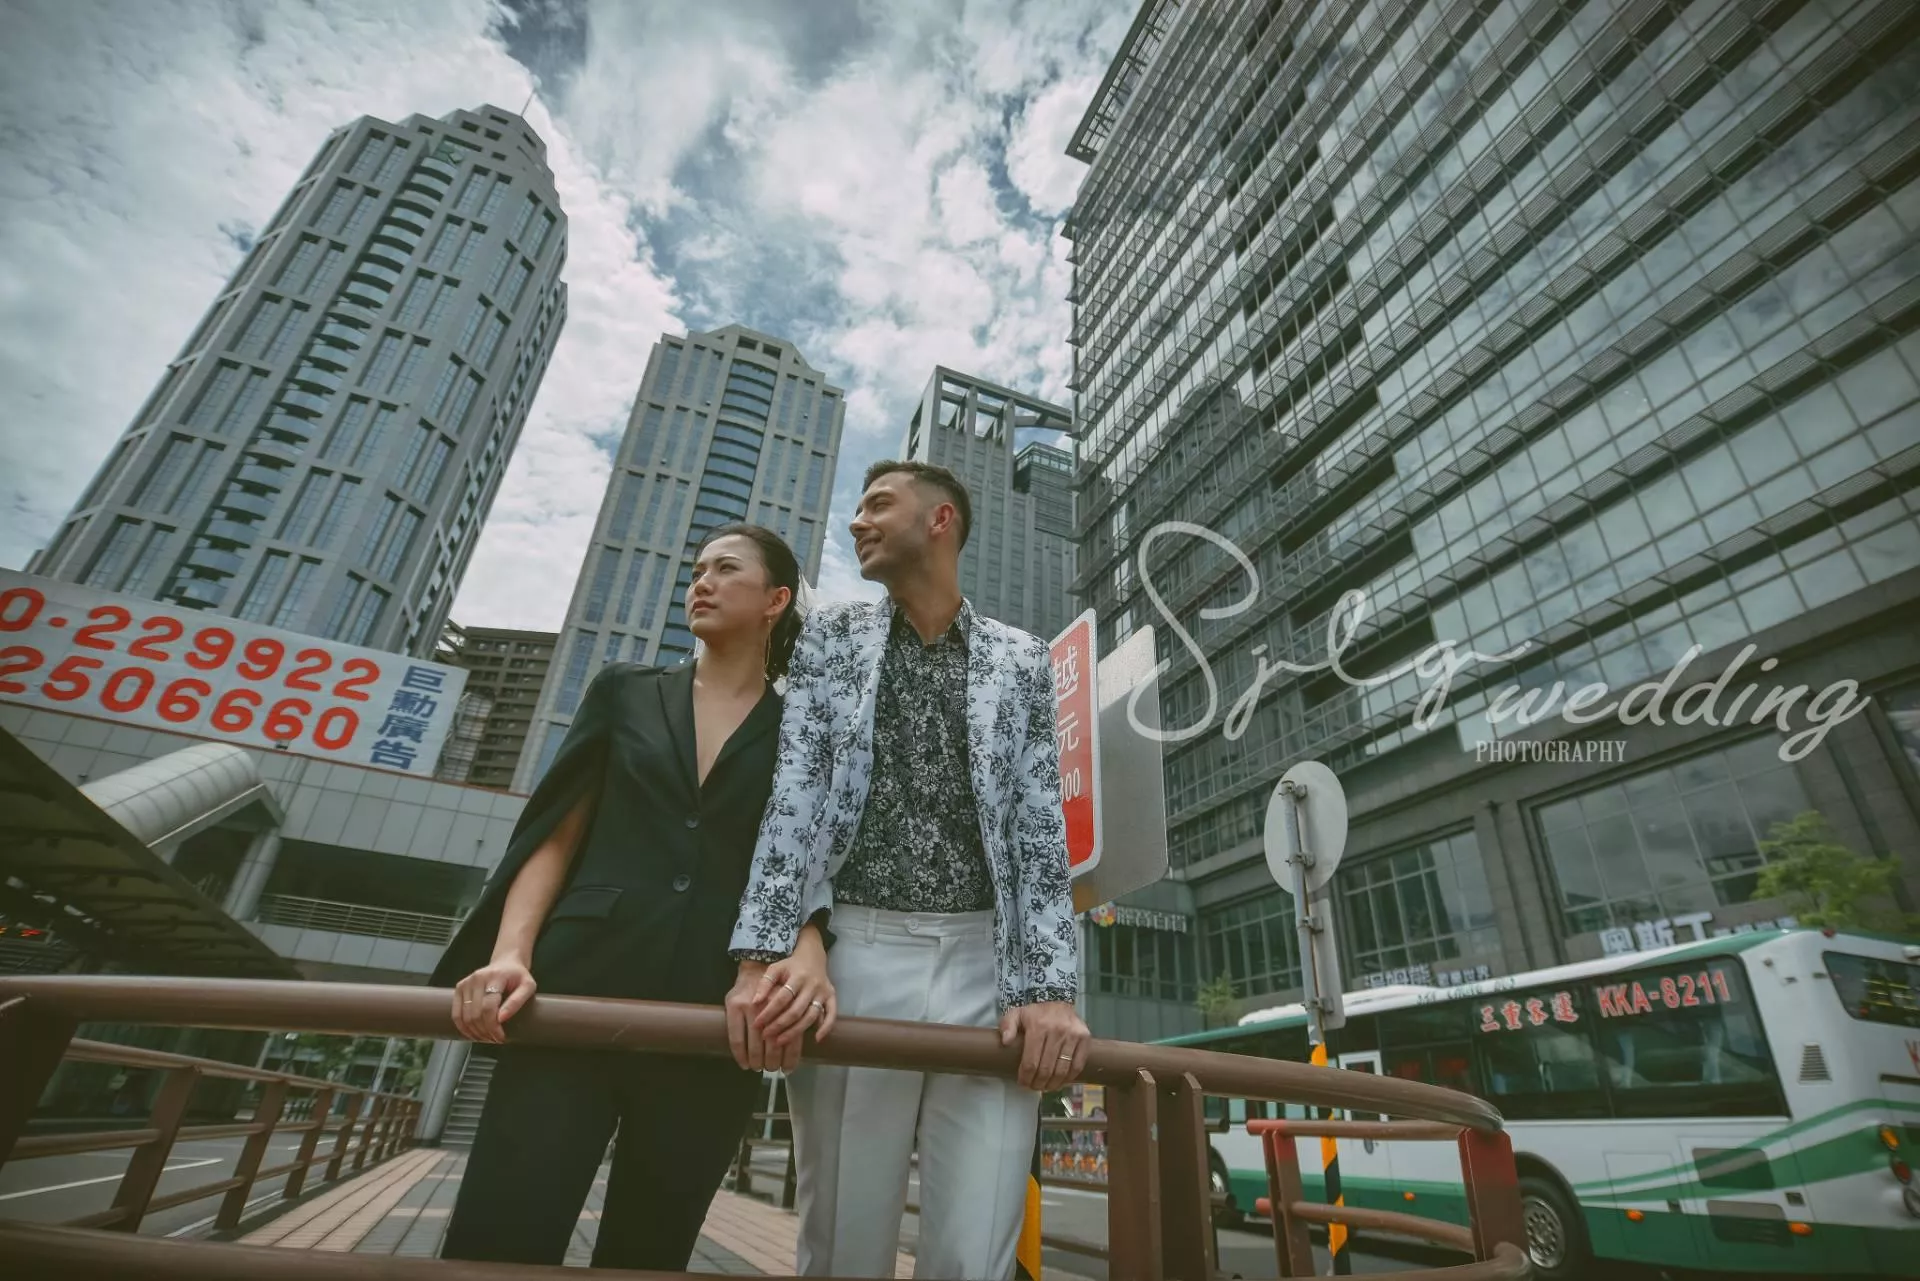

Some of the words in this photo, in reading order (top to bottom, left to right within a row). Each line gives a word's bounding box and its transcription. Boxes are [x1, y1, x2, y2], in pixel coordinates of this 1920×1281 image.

[0, 646, 360, 750] 2506660
[1480, 990, 1579, 1032] 三重客運
[1596, 970, 1730, 1018] KKA-8211
